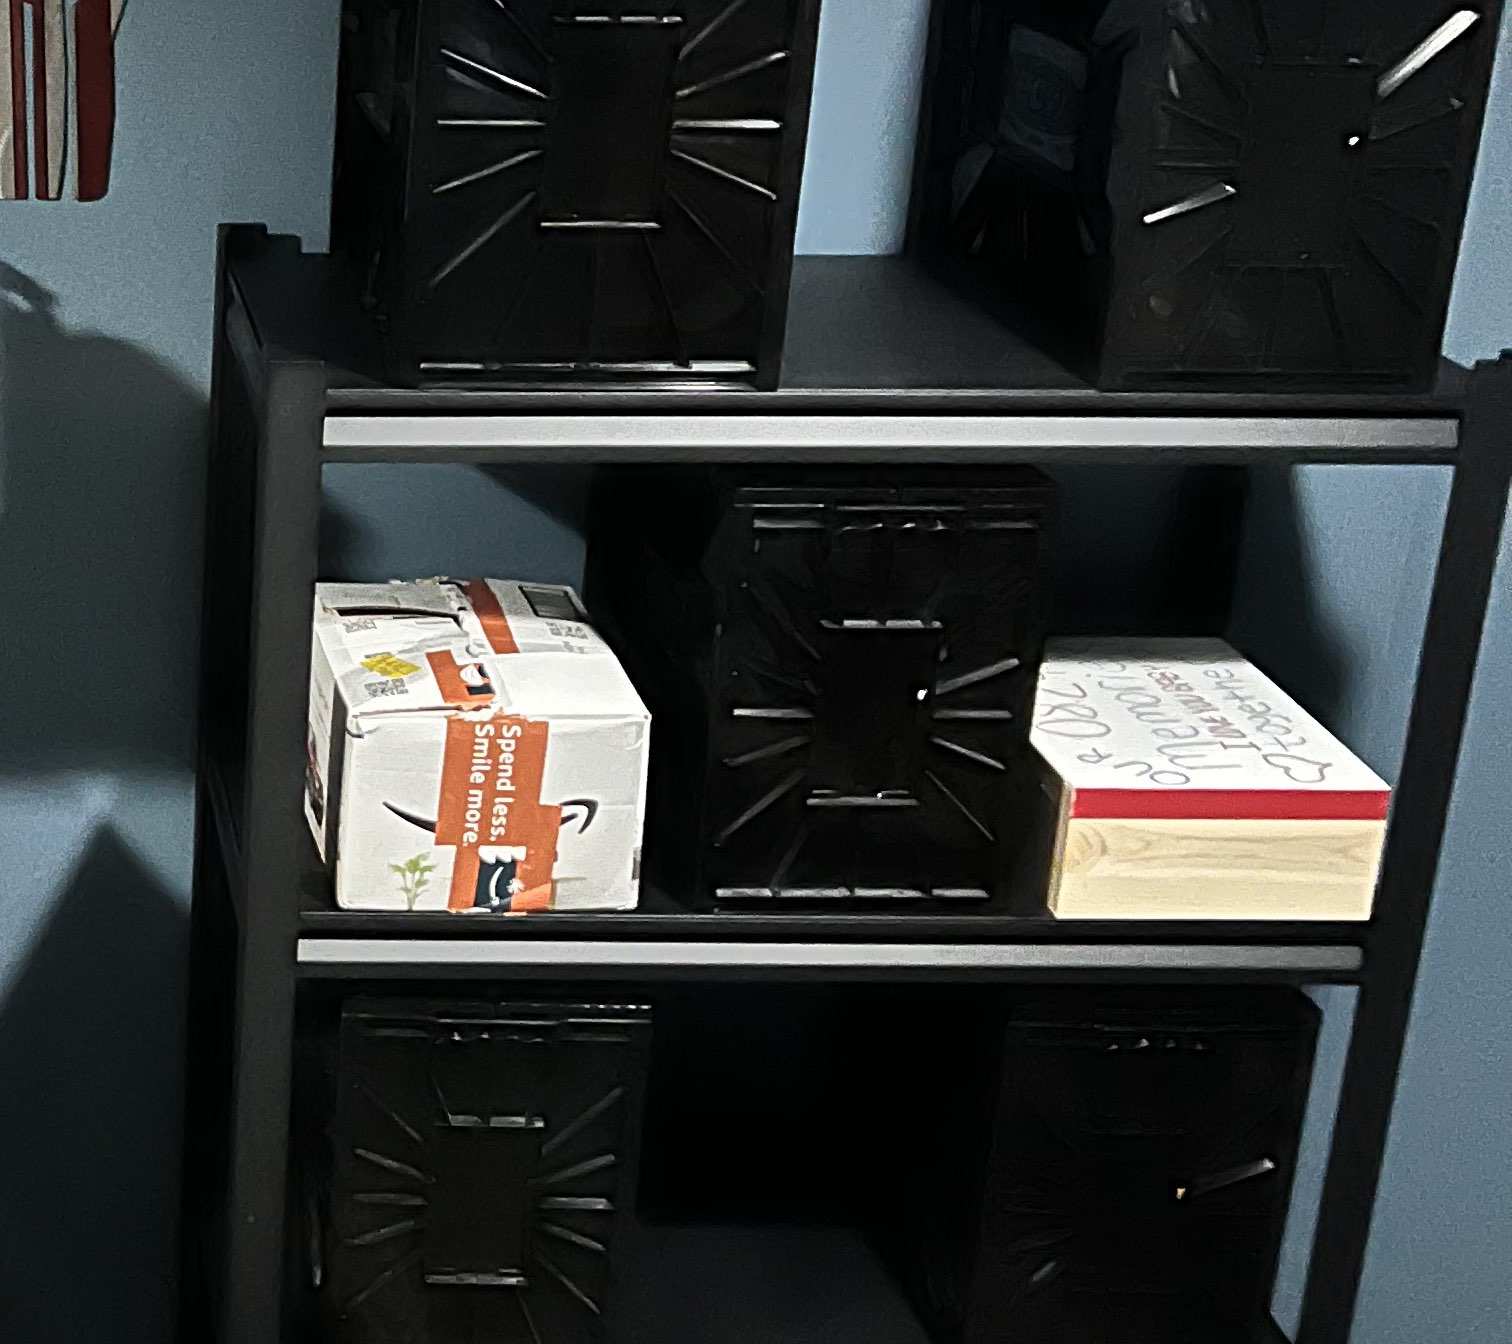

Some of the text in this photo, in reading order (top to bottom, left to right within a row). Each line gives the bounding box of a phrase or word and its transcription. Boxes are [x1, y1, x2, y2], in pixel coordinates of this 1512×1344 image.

[1078, 660, 1244, 771] Memorie
[1202, 668, 1307, 752] togethe
[462, 723, 495, 847] Smile more.
[489, 724, 522, 842] Spend less.
